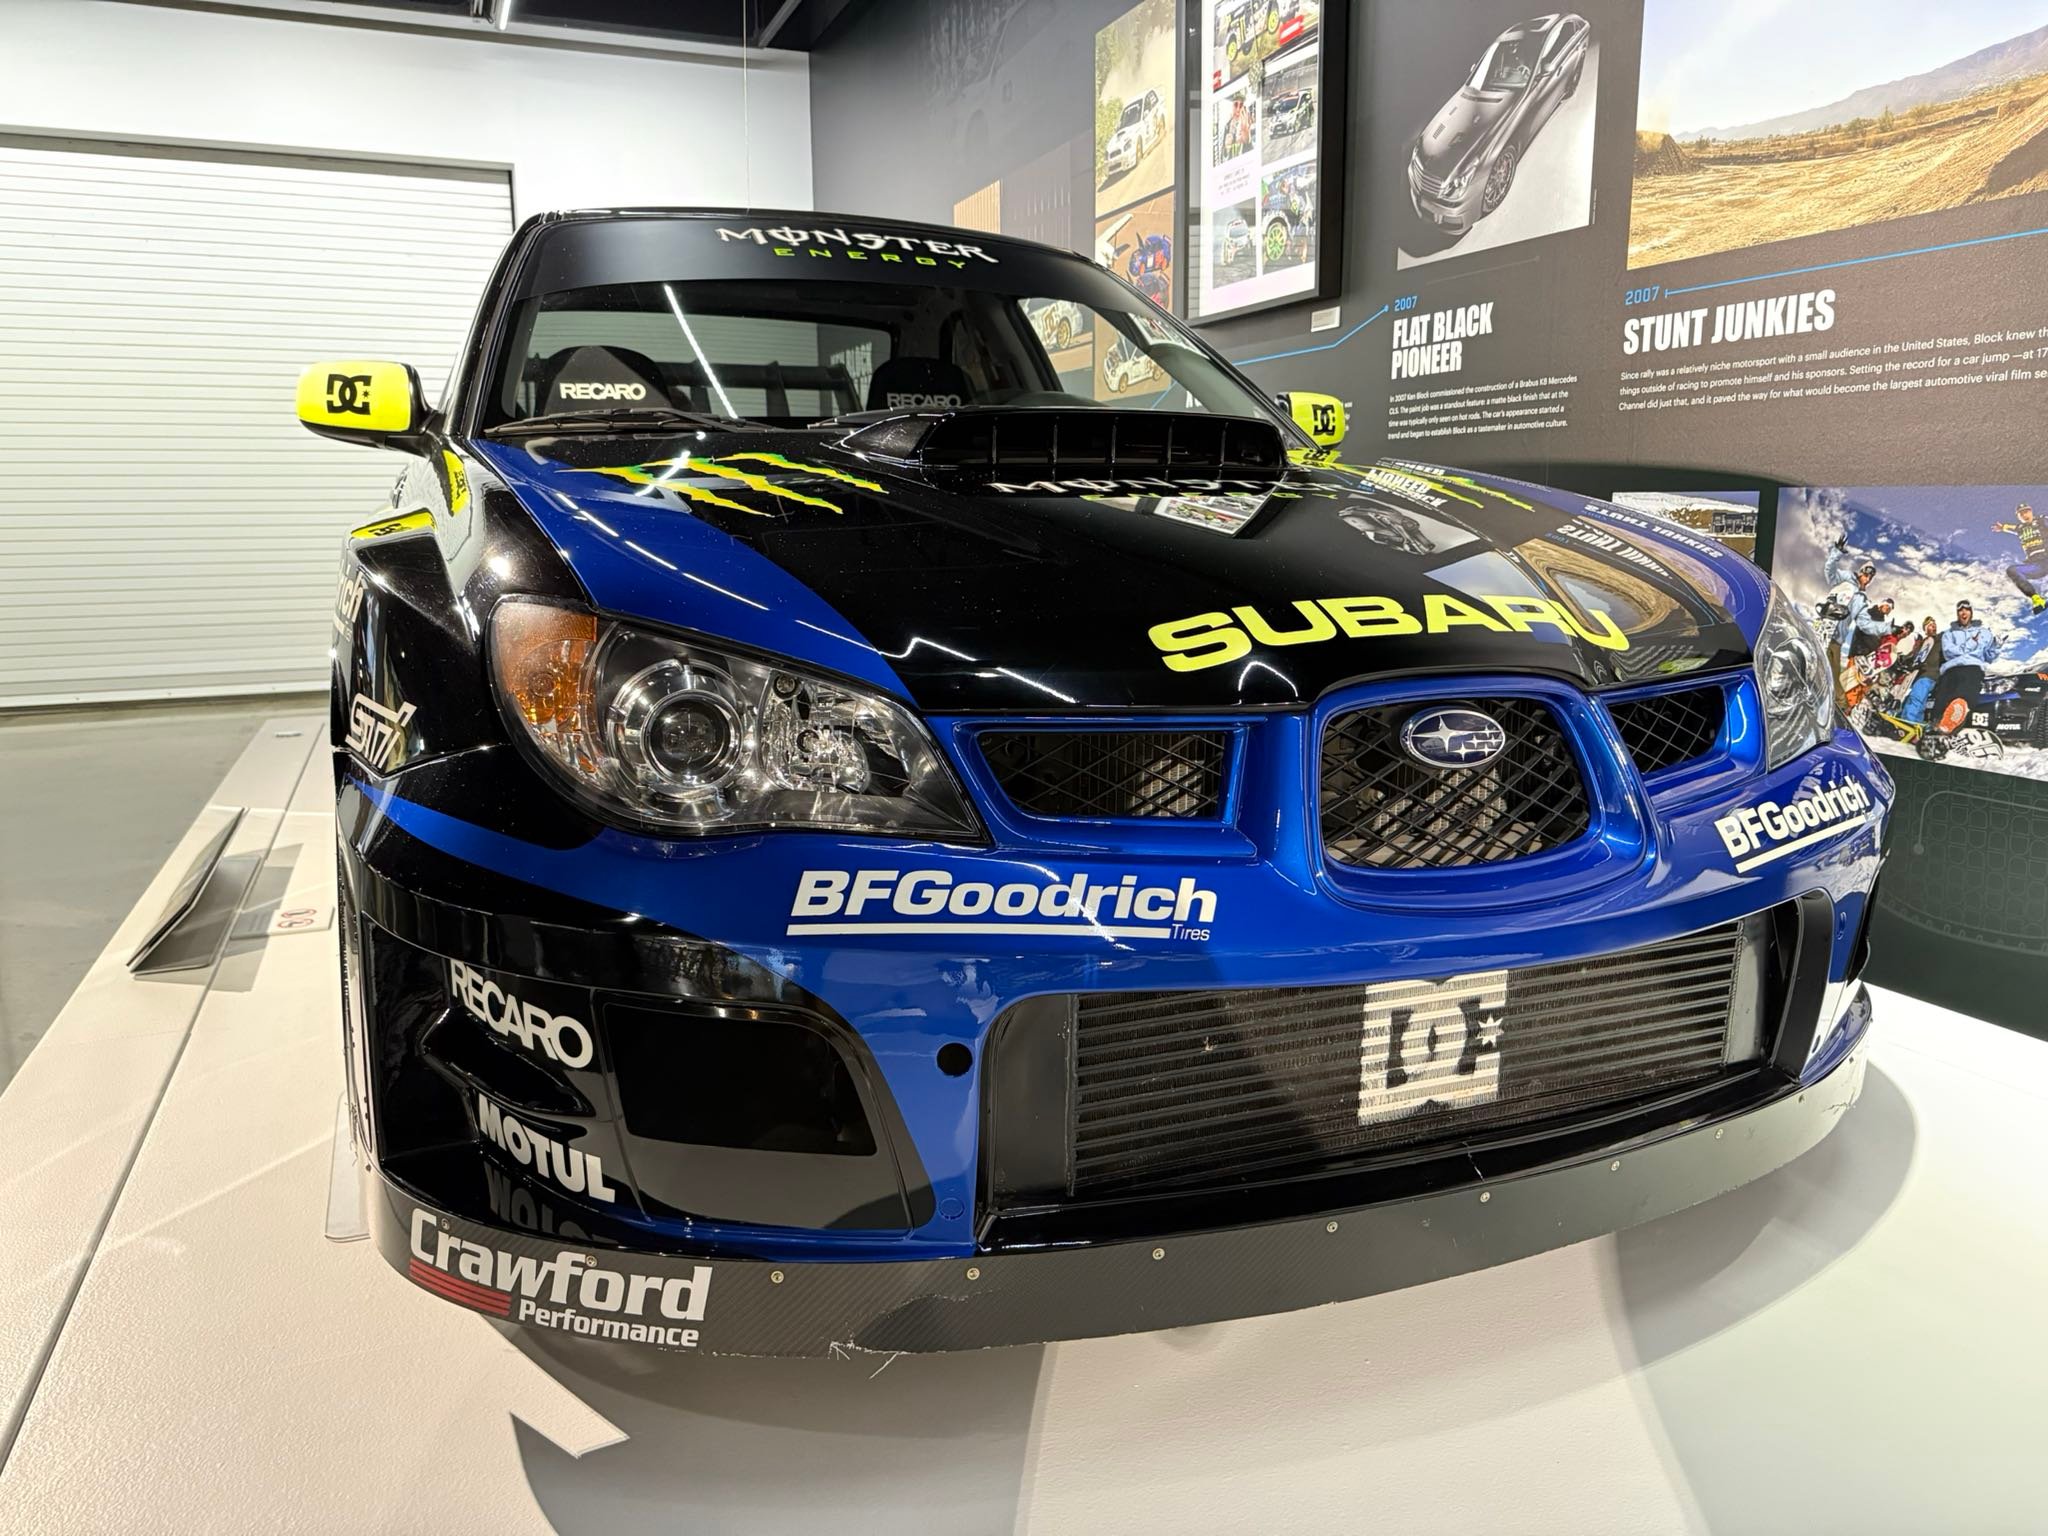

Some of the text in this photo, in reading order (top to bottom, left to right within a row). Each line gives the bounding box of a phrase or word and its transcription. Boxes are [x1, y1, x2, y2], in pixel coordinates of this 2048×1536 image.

[774, 247, 966, 270] ENERGY
[1394, 295, 1418, 312] 2007
[1625, 286, 1660, 306] 2007
[1392, 302, 1494, 349] FLAT BLACK
[1623, 289, 1836, 355] STUNT JUNKIES
[1391, 340, 1463, 380] PIONEER
[1619, 387, 1640, 396] things
[1641, 384, 1667, 394] outside
[1667, 381, 1676, 392] of
[1676, 380, 1699, 391] racing
[1700, 380, 1709, 388] to
[1709, 377, 1742, 389] promote
[1743, 372, 1773, 385] himself
[1774, 371, 1790, 381] and
[1791, 370, 1804, 380] his
[1805, 367, 1847, 380] sponsors.
[1849, 363, 1883, 375] Setting
[1885, 361, 1900, 372] the
[1903, 357, 1936, 370] record
[1937, 356, 1952, 367] for
[1962, 355, 1980, 365] car
[1981, 352, 2010, 366] jump
[1620, 371, 1639, 381] Since
[1640, 369, 1655, 378] rally
[1656, 368, 1669, 377] was
[1676, 363, 1709, 374] relatively
[1709, 361, 1731, 371] niche
[1732, 356, 1776, 368] motorsport
[1778, 352, 1796, 364] with
[1804, 350, 1827, 361] small
[1829, 347, 1871, 359] audience
[1872, 344, 1882, 354] in
[1883, 343, 1900, 353] the
[1901, 339, 1935, 351] United
[1936, 337, 1971, 348] States,
[1974, 331, 2003, 345] Block
[2006, 330, 2036, 341] knew
[327, 373, 372, 415] DC
[560, 383, 646, 400] RECARO
[887, 392, 962, 408] RECARO
[1474, 383, 1507, 393] construction
[1548, 374, 1577, 384] Mercedes
[1507, 394, 1521, 403] black
[1523, 392, 1538, 401] finish
[1539, 391, 1550, 400] that
[1558, 390, 1569, 398] the
[1618, 400, 1646, 411] Channel
[1647, 399, 1658, 408] did
[1658, 398, 1672, 409] just
[1690, 395, 1705, 405] and
[1713, 392, 1736, 405] paved
[1737, 391, 1751, 401] the
[1752, 392, 1768, 401] way
[1769, 389, 1781, 399] for
[1783, 387, 1804, 398] what
[1805, 384, 1832, 396] would
[1833, 384, 1870, 394] become
[1872, 380, 1888, 391] the
[1889, 378, 1923, 391] largest
[1924, 373, 1983, 387] automotive
[1985, 370, 2008, 382] viral
[2010, 369, 2032, 380] film
[1312, 404, 1336, 436] DC
[1453, 425, 1466, 434] Block
[1513, 420, 1545, 430] automotive
[1545, 418, 1568, 428] culture.
[1482, 410, 1492, 418] The
[1506, 407, 1538, 417] appearance
[1539, 404, 1560, 414] started
[1148, 594, 1630, 672] SUBARU
[344, 692, 418, 769] STI
[1714, 775, 1871, 858] BFGoodrich
[790, 870, 1217, 922] BFGoodrich
[1171, 923, 1211, 941] Tires
[450, 959, 593, 1069] RECARO
[1358, 969, 1509, 1127] DC
[479, 1092, 616, 1204] MOTUL
[410, 1207, 713, 1321] Crawford
[518, 1298, 700, 1347] Performance
